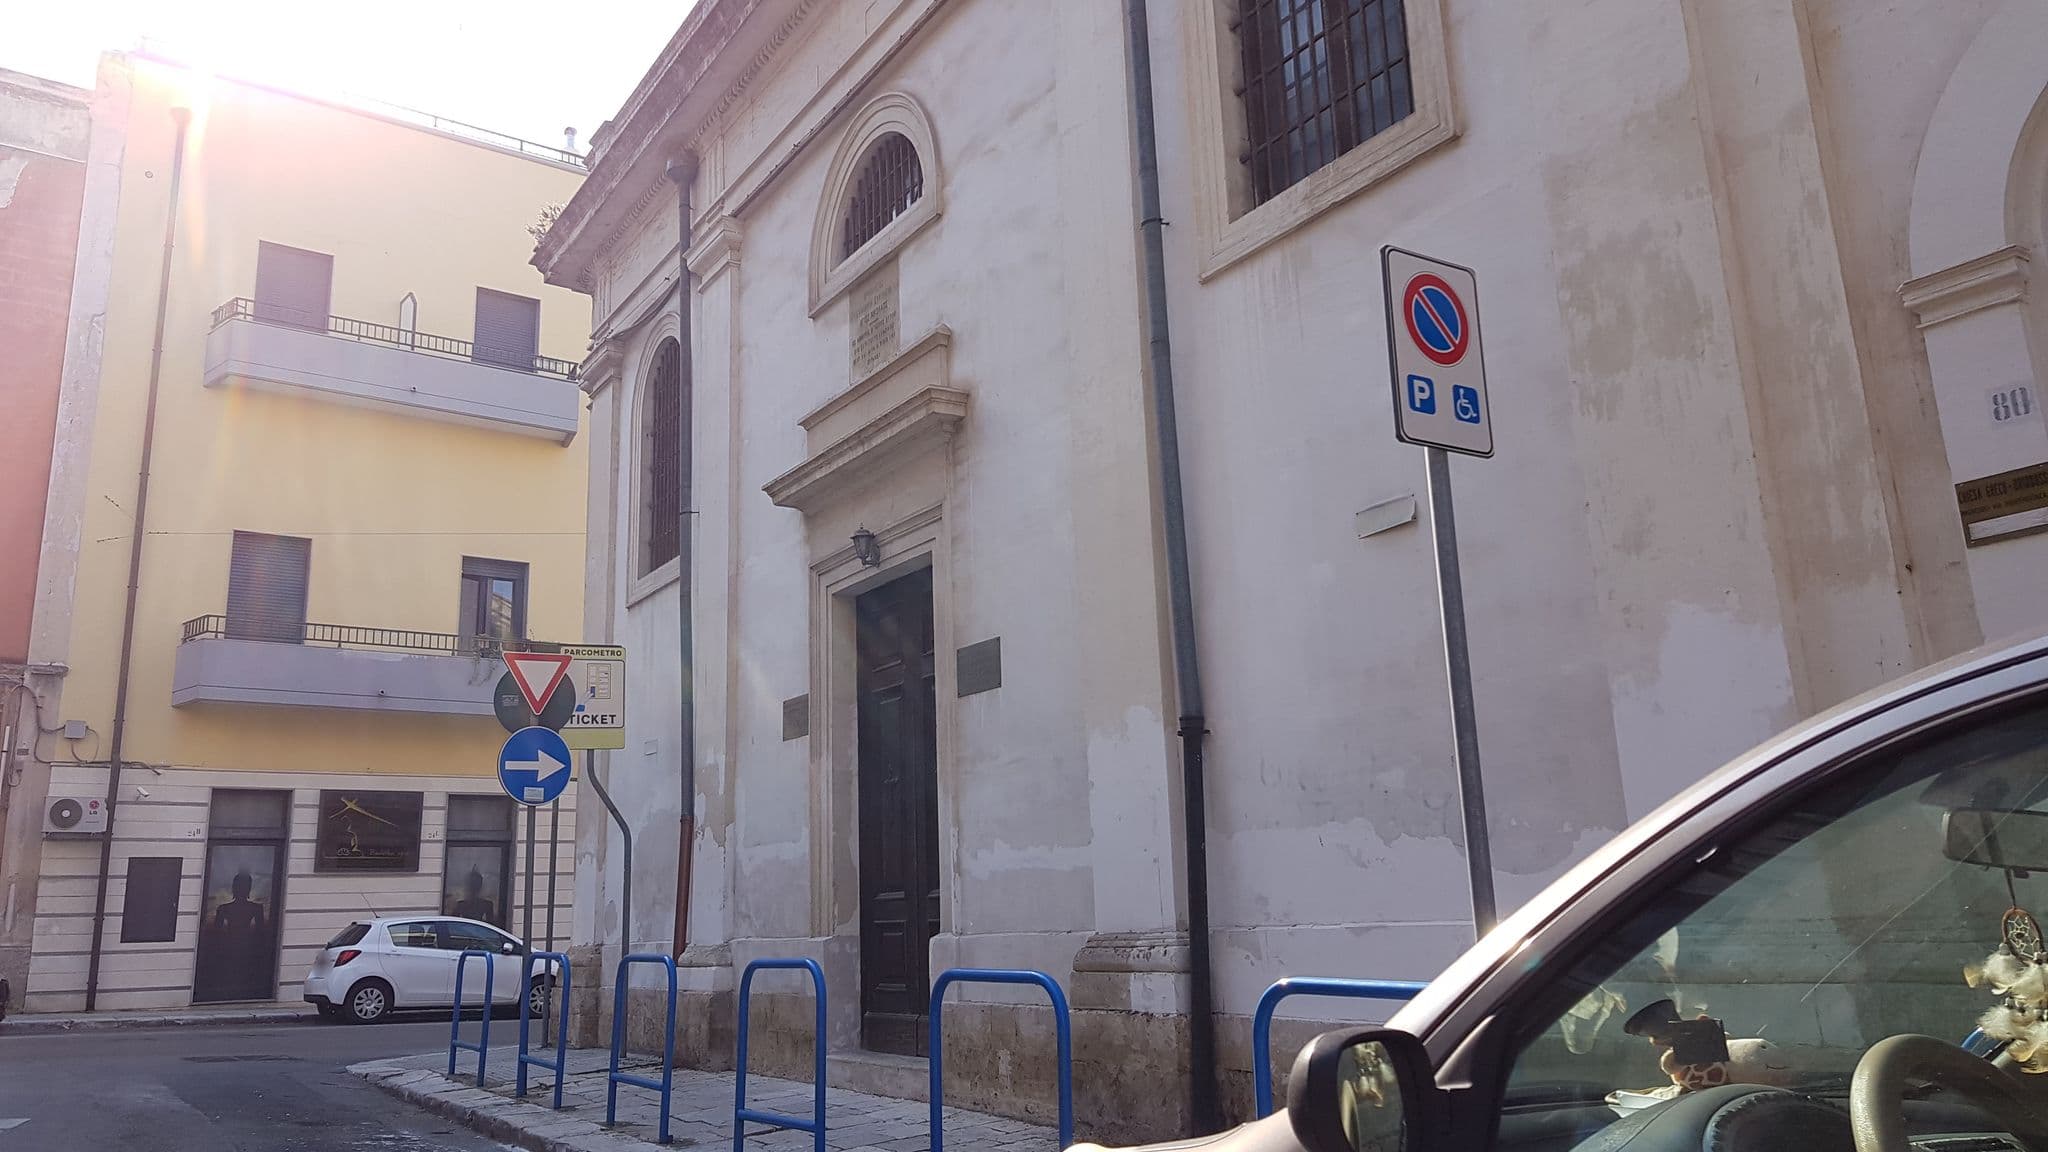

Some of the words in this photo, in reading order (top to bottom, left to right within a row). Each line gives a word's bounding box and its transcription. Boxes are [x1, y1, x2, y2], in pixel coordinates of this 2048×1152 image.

[1413, 379, 1431, 409] P
[1992, 387, 2031, 421] 80
[564, 648, 622, 657] PARCOMETRO
[569, 714, 617, 725] TICKET
